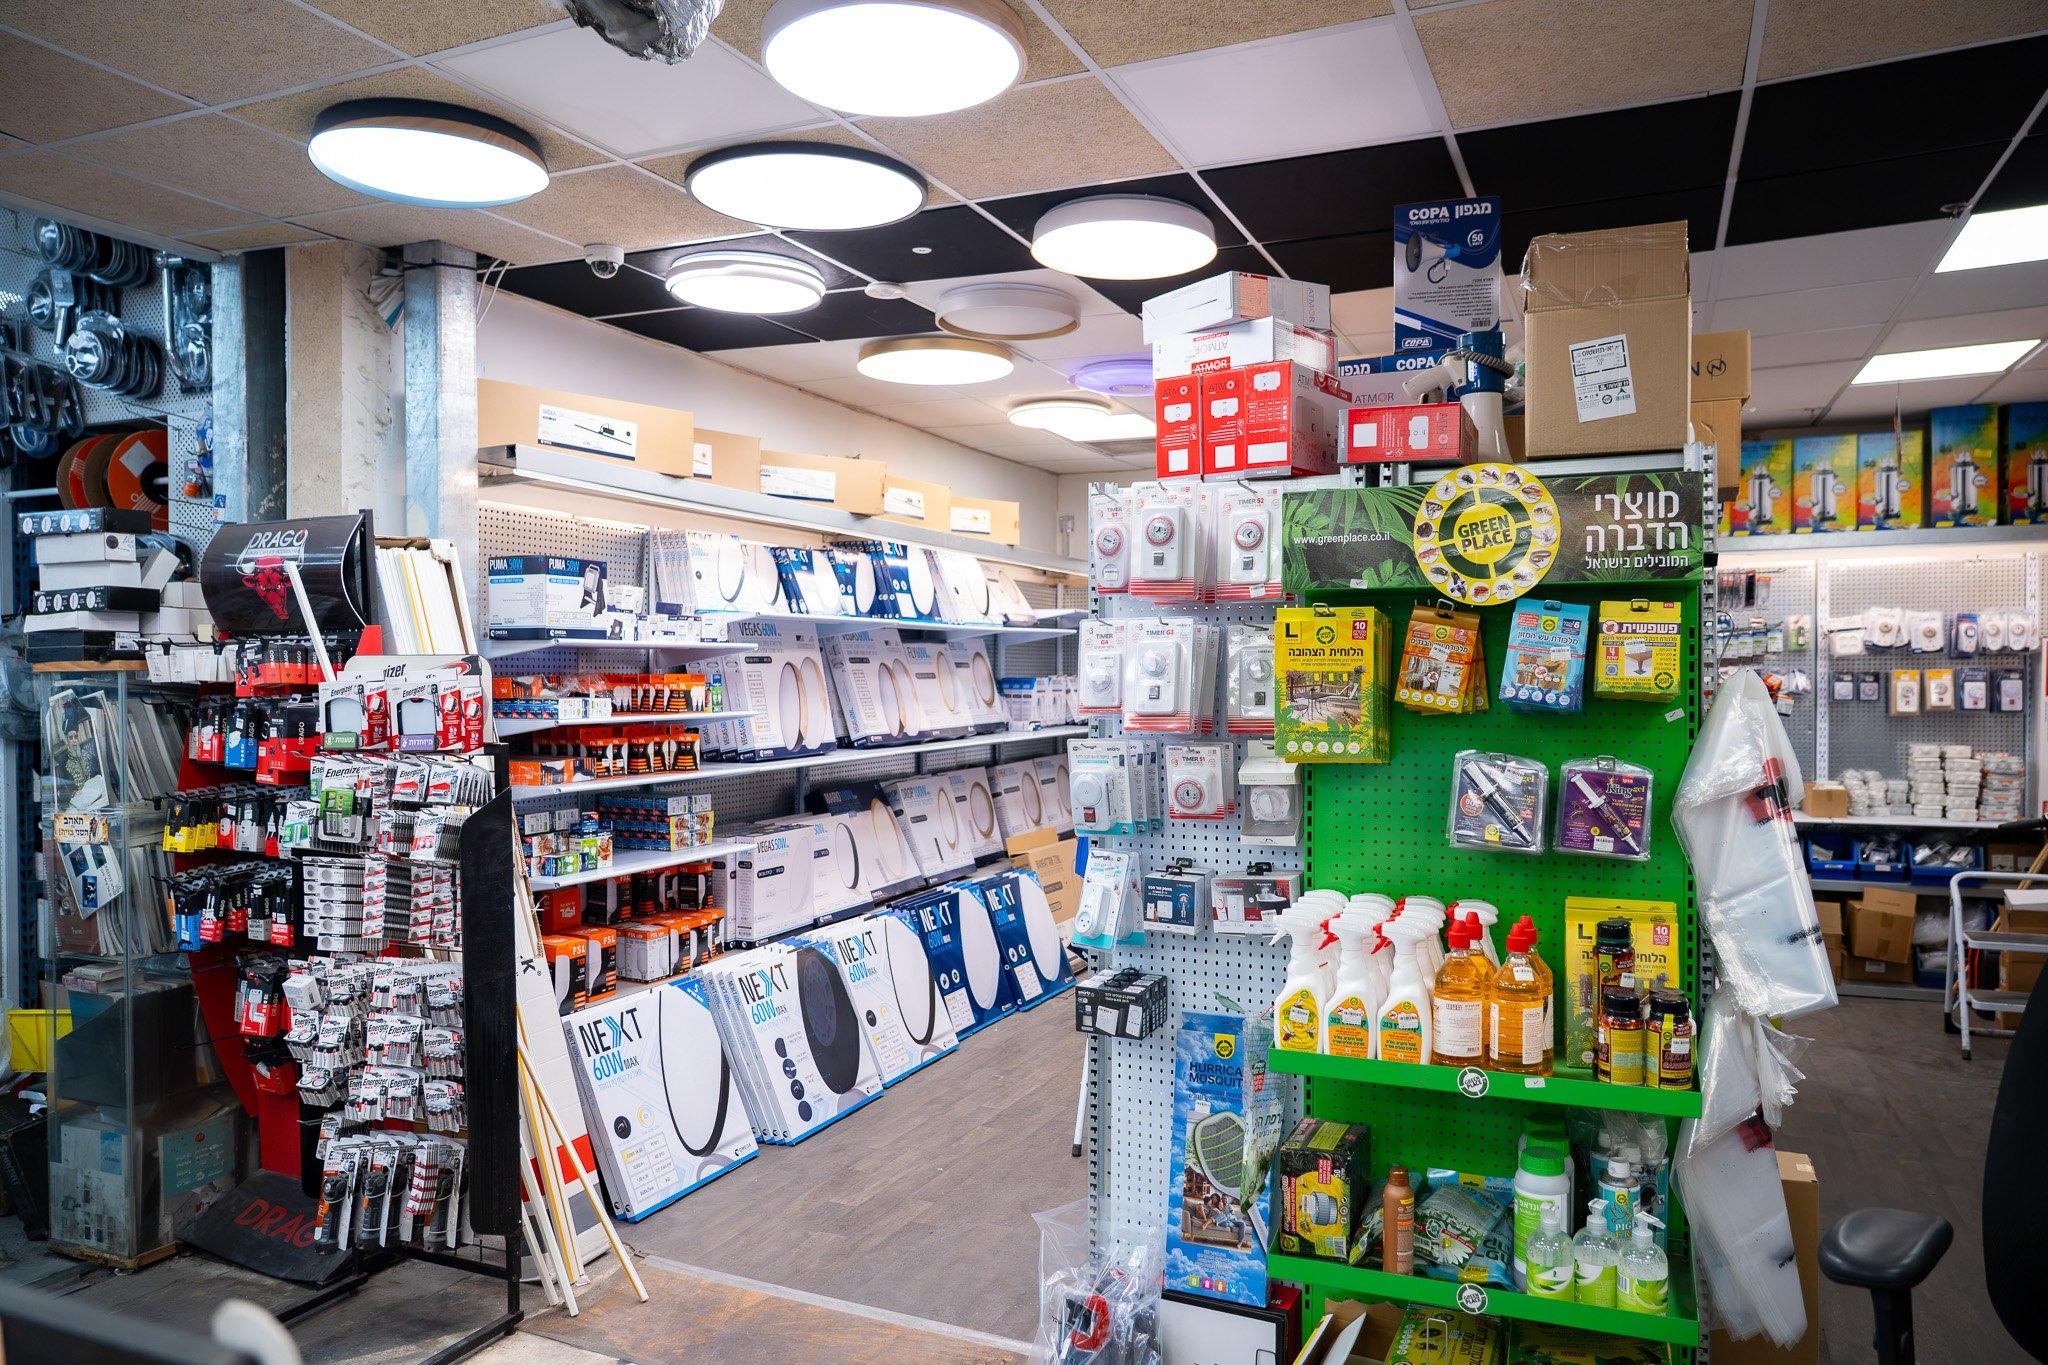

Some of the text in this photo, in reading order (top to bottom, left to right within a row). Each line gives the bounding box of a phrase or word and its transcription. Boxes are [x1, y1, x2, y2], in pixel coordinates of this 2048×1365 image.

[1409, 203, 1492, 220] COPA מגפון
[1472, 233, 1483, 242] 50
[1307, 286, 1316, 323] ATMOR
[1404, 339, 1430, 347] COPA
[1192, 359, 1228, 373] ATMOR
[1396, 356, 1435, 371] COPA
[1354, 392, 1394, 404] ATMOR
[1595, 490, 1680, 520] מוצרי
[1457, 514, 1510, 539] GREEN
[249, 528, 308, 548] DRAGO
[1293, 531, 1390, 547] www.greenplace.co.il
[1461, 529, 1512, 552] PLACE
[1586, 522, 1689, 552] הדברה
[489, 558, 508, 570] PUMA
[548, 558, 566, 570] PUMA
[1586, 554, 1689, 569] המובילים בישראל
[738, 622, 762, 637] VEGAS
[1285, 622, 1366, 638] L 10
[1622, 624, 1678, 634] פשפשית
[1551, 636, 1579, 645] מלכודת
[1288, 647, 1364, 657] הלוחית הצהובה
[330, 684, 353, 698] Energizer
[402, 684, 426, 699] Energizer
[1606, 784, 1633, 798] King
[418, 816, 445, 827] Energizer
[757, 838, 775, 853] VEGAS
[986, 884, 1016, 912] NEXT
[919, 901, 952, 932] NEXT
[995, 910, 1008, 926] 60W
[1578, 923, 1668, 940] L 10
[928, 932, 944, 948] 60W
[838, 931, 877, 965] NEXT
[848, 962, 870, 983] 60W
[393, 975, 421, 988] Energizer
[738, 963, 789, 1005] NEXT
[751, 999, 788, 1025] 60W MAX
[320, 1024, 347, 1036] Energizer
[388, 1024, 419, 1036] Energizer
[579, 1008, 643, 1058] NEXT
[593, 1050, 640, 1082] 60W MAX
[362, 1078, 388, 1088] Energizer
[390, 1077, 418, 1089] Energizer
